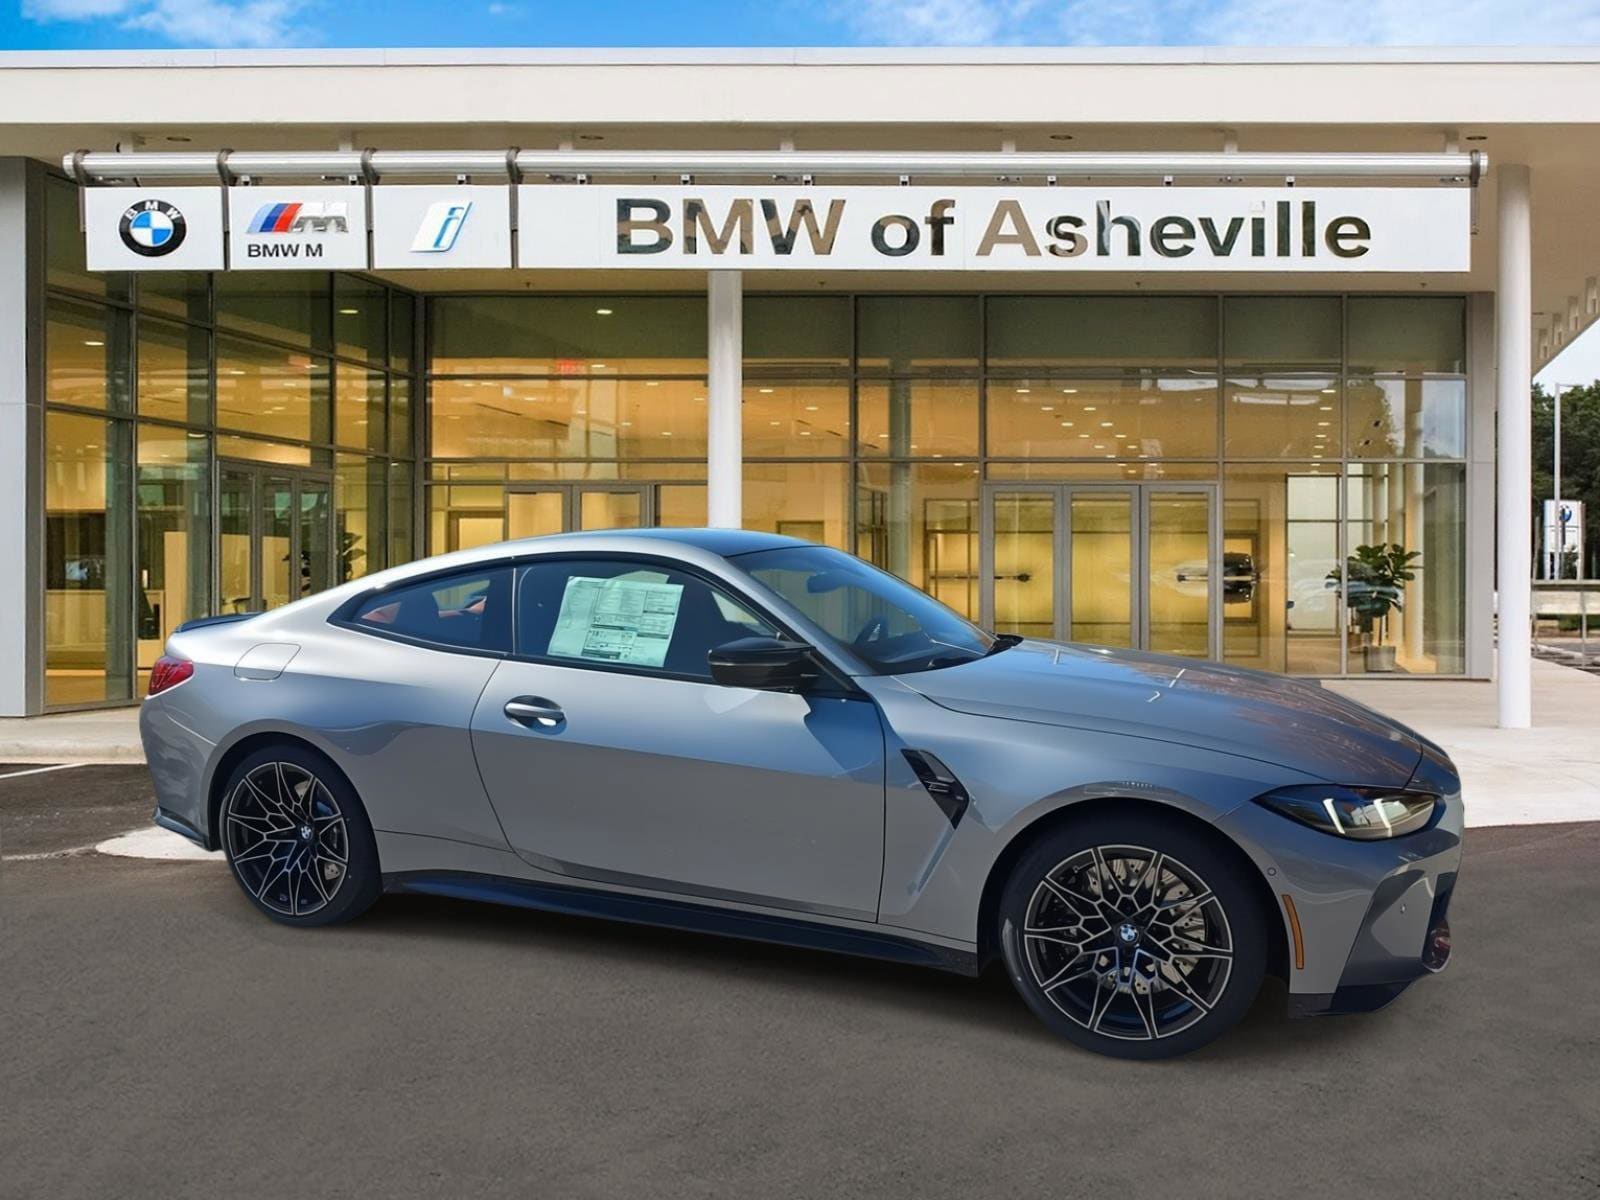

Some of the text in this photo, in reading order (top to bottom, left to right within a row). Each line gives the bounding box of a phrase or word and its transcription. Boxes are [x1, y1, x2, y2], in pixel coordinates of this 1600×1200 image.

[125, 201, 181, 220] BMW
[616, 198, 1372, 258] BMW of Asheville
[247, 243, 323, 258] BMW M
